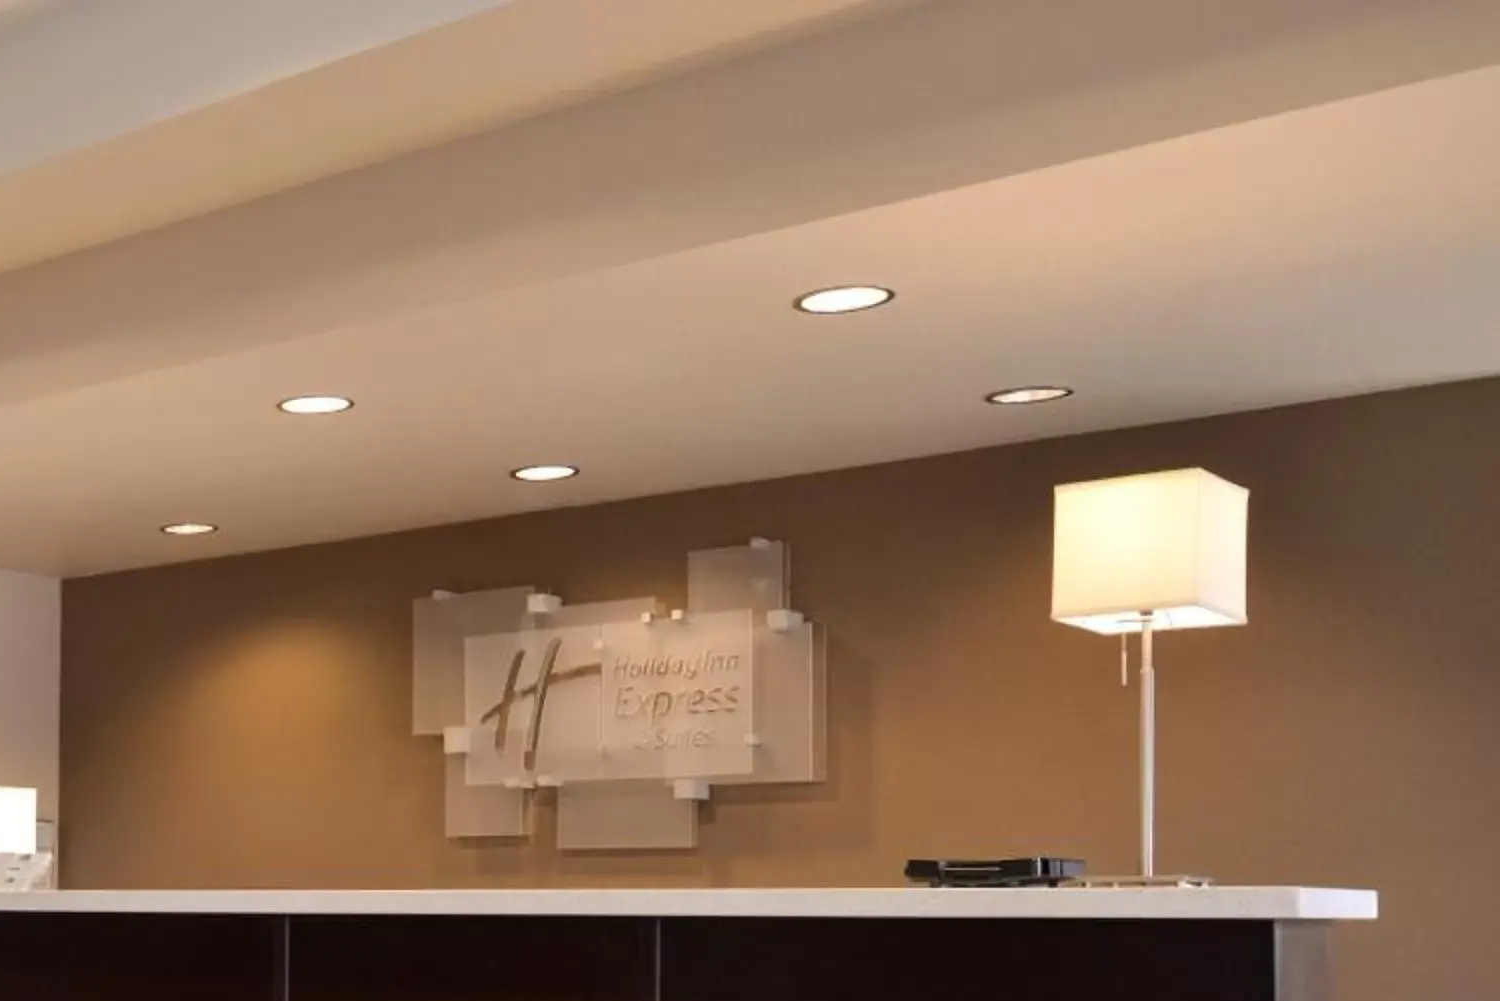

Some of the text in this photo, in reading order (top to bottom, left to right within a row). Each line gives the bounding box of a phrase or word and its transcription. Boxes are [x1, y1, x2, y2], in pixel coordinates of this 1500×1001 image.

[612, 649, 740, 680] Holiday Inn
[614, 686, 741, 726] Express
